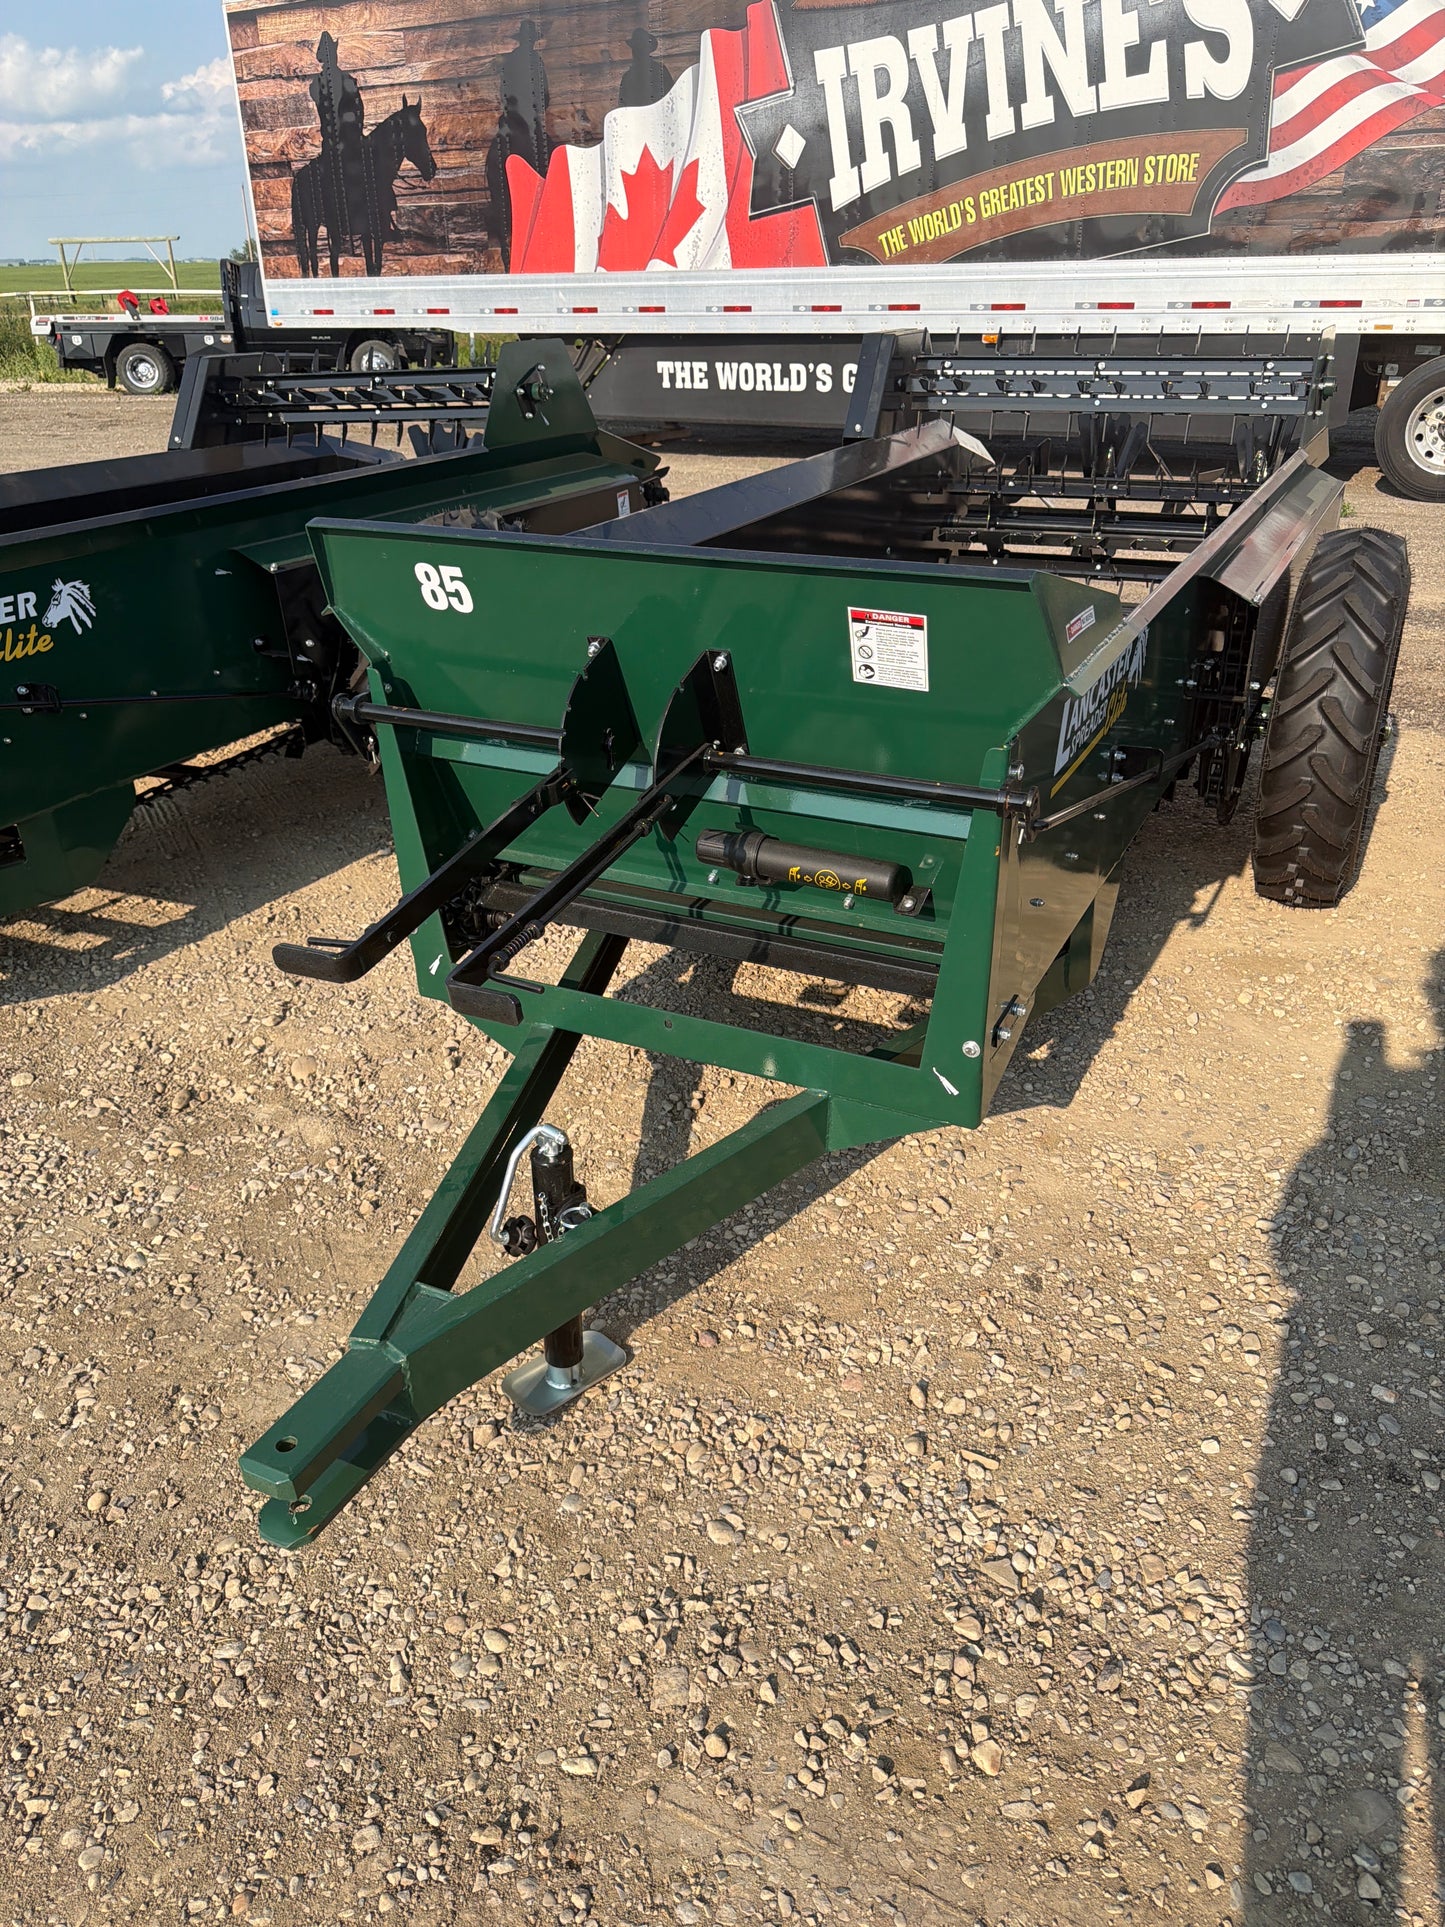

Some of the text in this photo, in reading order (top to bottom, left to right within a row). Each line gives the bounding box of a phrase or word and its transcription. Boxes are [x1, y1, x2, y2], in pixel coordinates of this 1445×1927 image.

[813, 0, 1254, 213] IRVINES
[878, 153, 1200, 258] THE WORLD'S GREATEST WESTERN STORE
[656, 360, 709, 390] THE
[715, 361, 833, 393] WORLD'S
[414, 562, 474, 614] 85
[0, 623, 54, 662] lite
[872, 613, 910, 623] DANGER
[1054, 641, 1133, 777] LANCASTER
[1070, 699, 1108, 758] SPREADER
